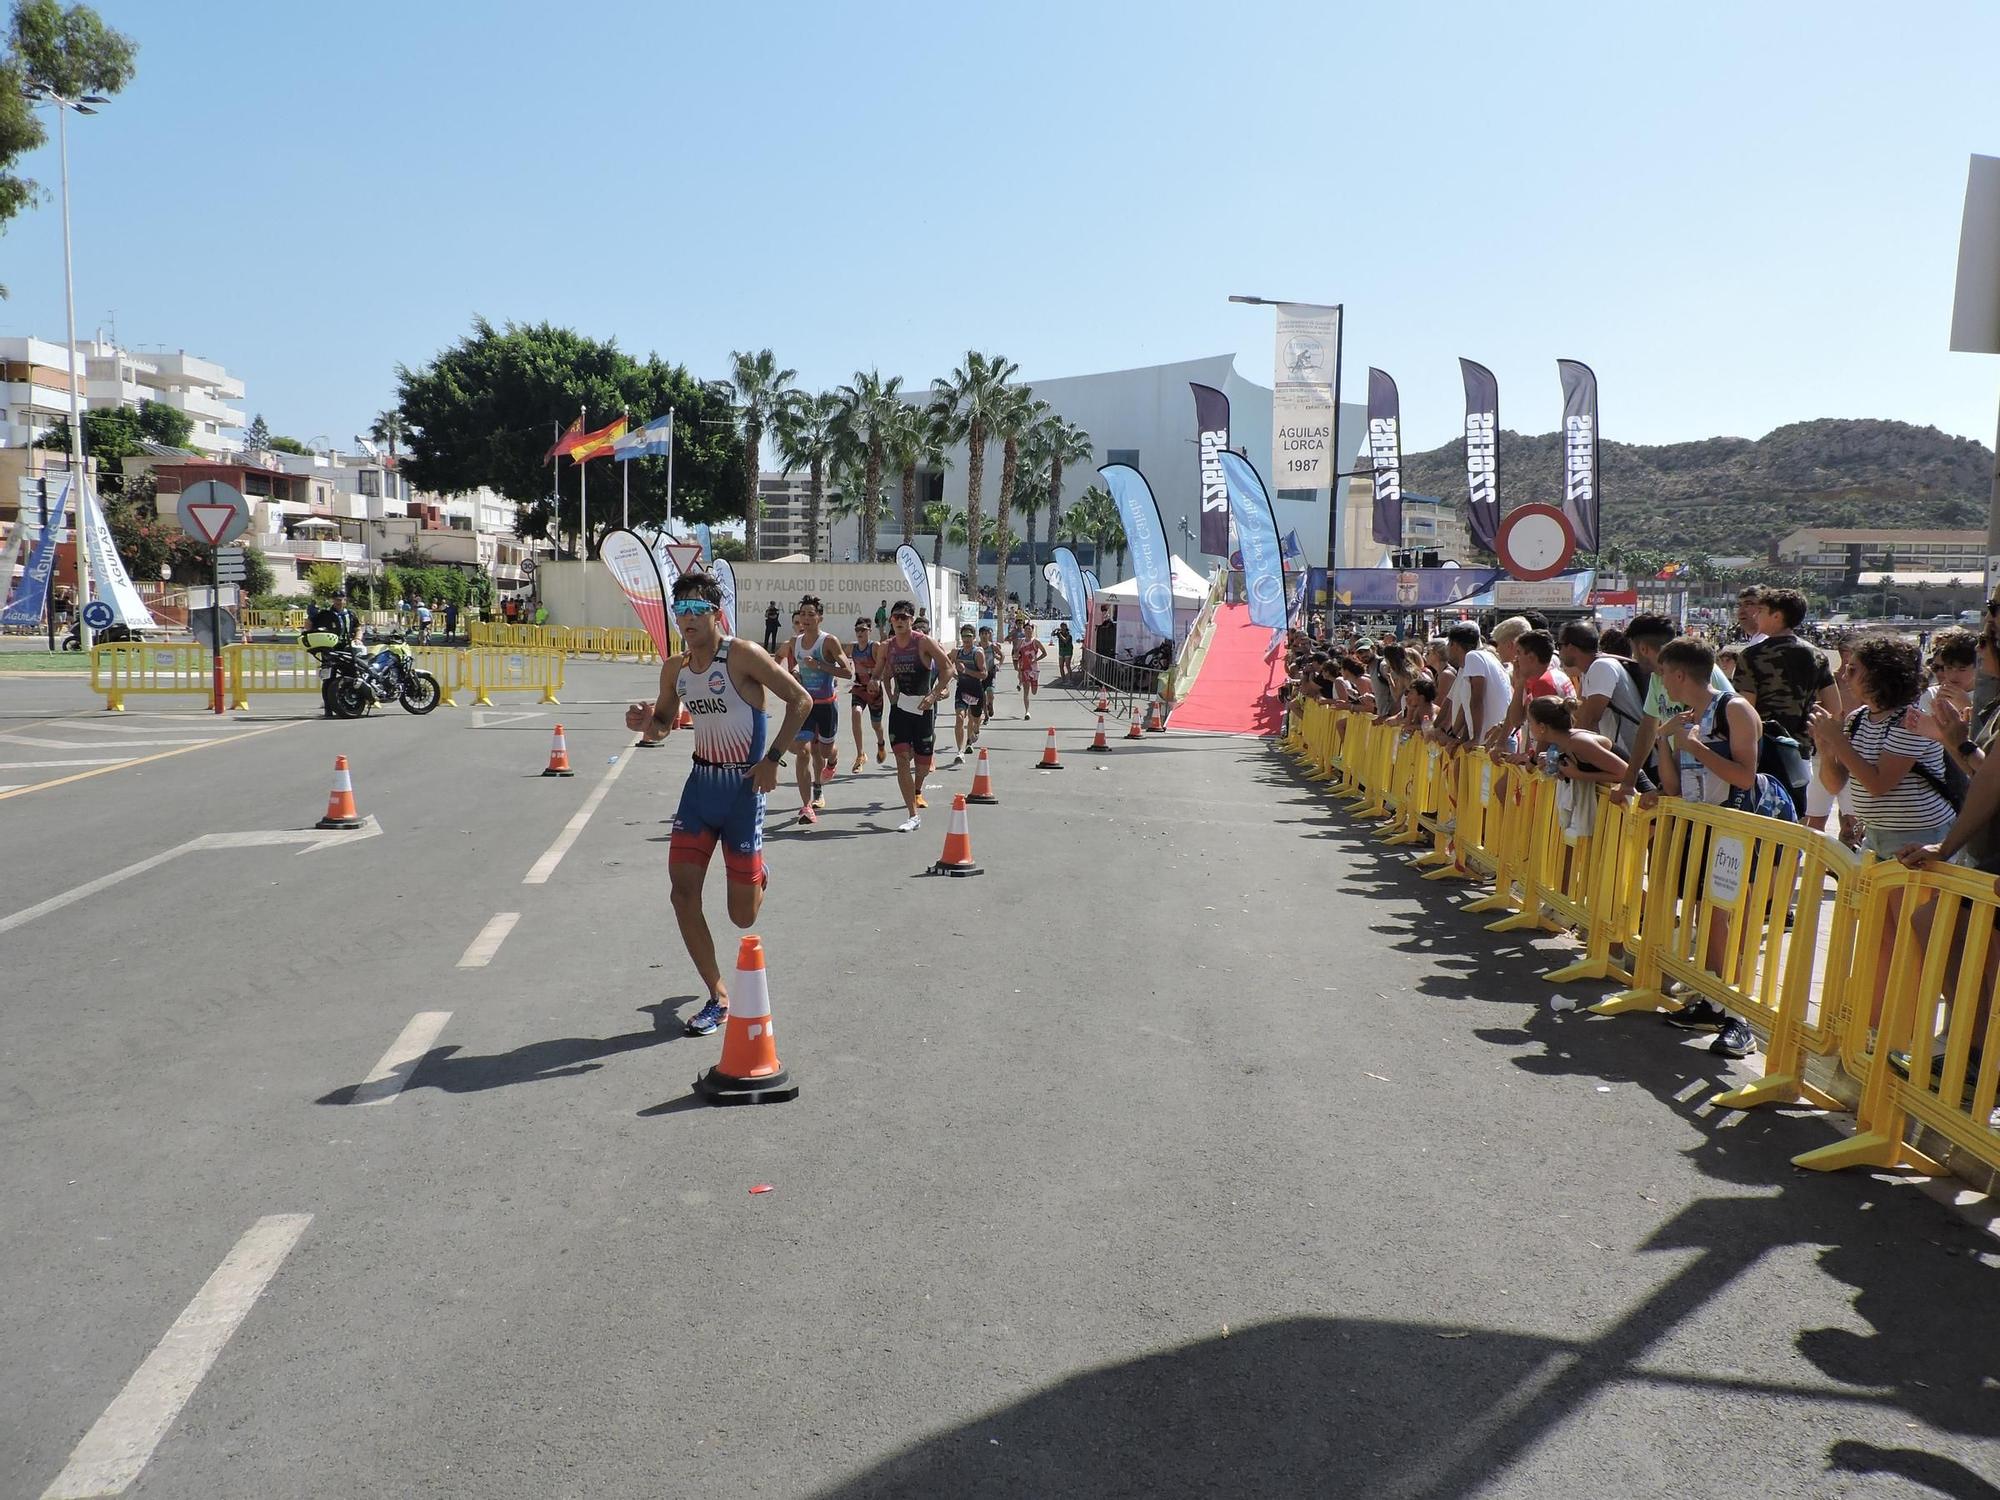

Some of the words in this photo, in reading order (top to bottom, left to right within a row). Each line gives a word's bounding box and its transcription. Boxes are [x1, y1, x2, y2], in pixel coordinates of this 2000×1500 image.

[1278, 425, 1330, 438] ÁGUILAS
[1283, 439, 1324, 451] LORCA
[1287, 459, 1319, 472] 1987
[755, 579, 763, 592] Y
[766, 579, 815, 592] PALACIO
[820, 580, 834, 592] DE
[838, 579, 910, 593] CONGRESOS
[825, 602, 862, 614] ELENA
